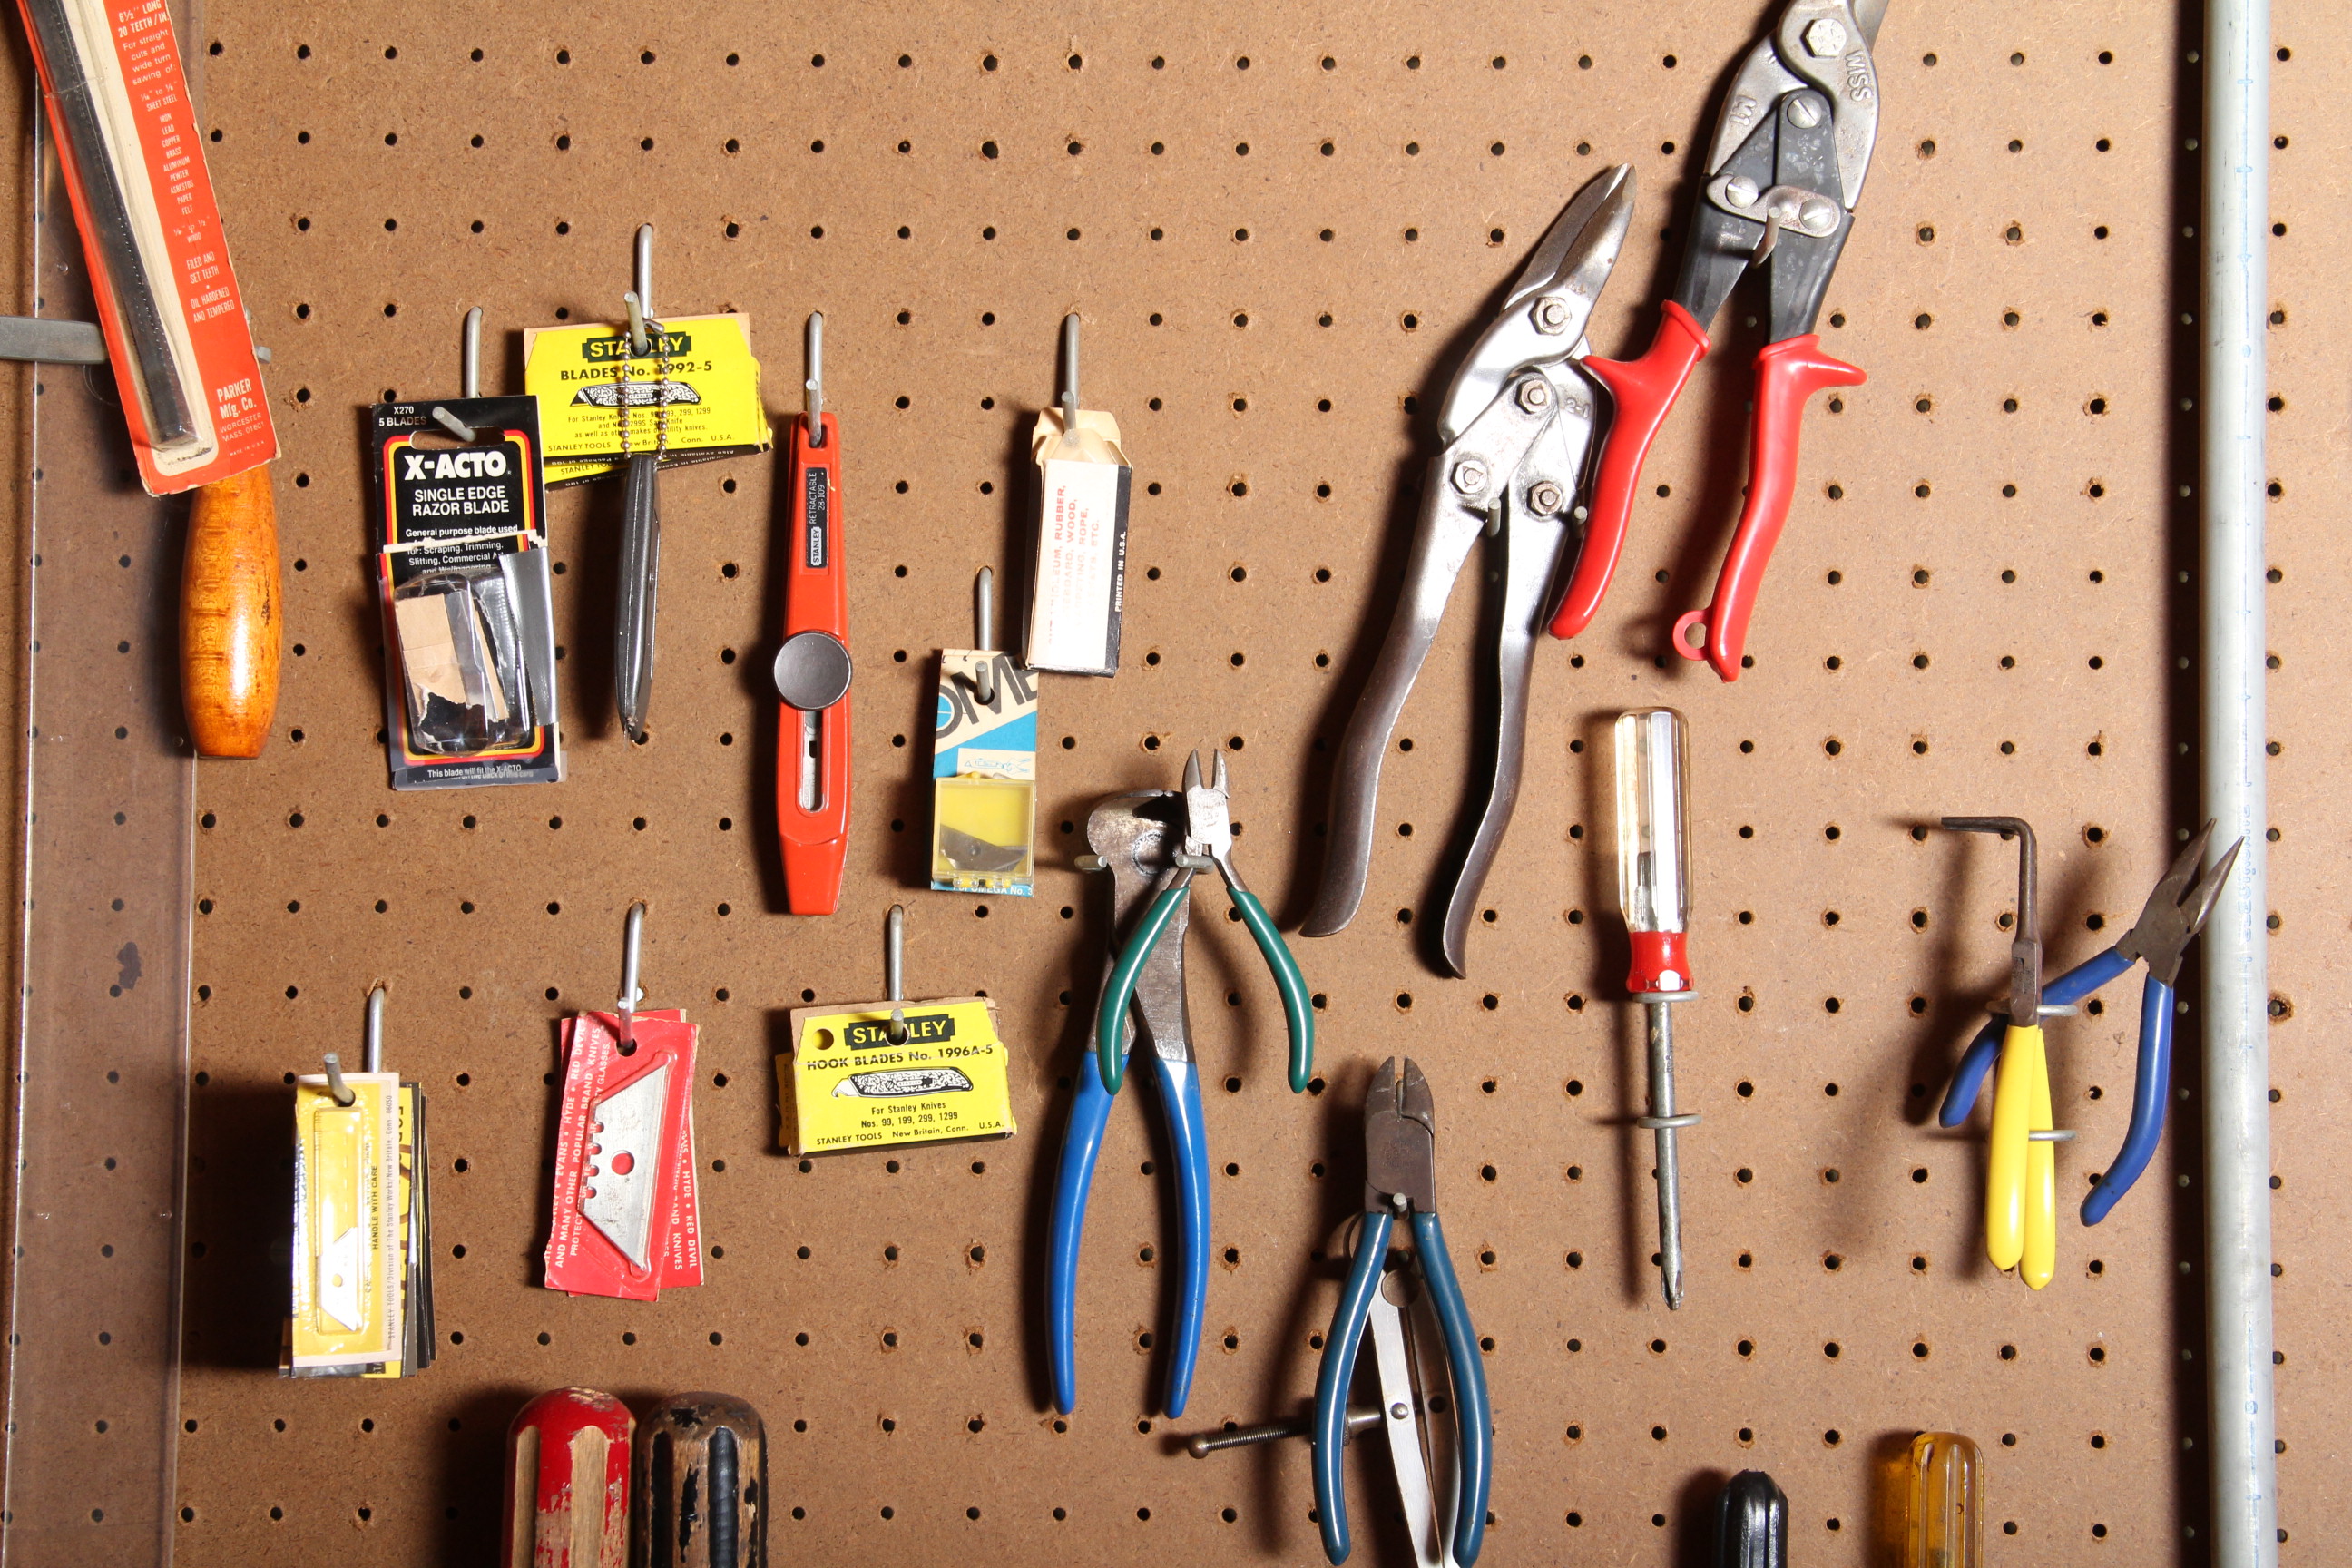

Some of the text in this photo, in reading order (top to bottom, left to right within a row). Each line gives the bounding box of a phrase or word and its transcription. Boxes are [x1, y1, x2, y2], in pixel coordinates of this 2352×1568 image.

[142, 0, 162, 15] LONG
[118, 26, 128, 38] 20
[122, 29, 169, 51] For straight
[131, 43, 165, 61] cuts and
[132, 54, 171, 73] wide turn
[132, 70, 162, 85] sawing
[1845, 49, 1873, 102] WISS
[146, 94, 178, 112] SHEET STEEL
[160, 113, 172, 123] IRON
[162, 124, 175, 135] LEAD
[162, 134, 181, 148] COPPER
[165, 146, 182, 159] BRASS
[163, 156, 191, 172] ALUMINUM
[170, 169, 190, 182] PEWTER
[170, 180, 194, 195] ASBESTOS
[177, 192, 193, 205] PAPER
[181, 205, 193, 216] FELT
[186, 251, 216, 270] FILED AND
[190, 265, 220, 284] SET TEETH
[190, 286, 230, 309] OIL HARDENED
[192, 299, 235, 323] AND TEMPERED
[561, 367, 618, 381] BLADES
[216, 378, 252, 403] PARKER
[219, 397, 257, 419] Mfg. Co.
[394, 406, 414, 415] X270
[220, 412, 262, 433] WORCESTER
[378, 416, 426, 426] 5 BLADES
[582, 415, 606, 423] Stanley
[548, 443, 583, 452] STANLEY
[404, 451, 507, 481] X-ACTO
[415, 486, 506, 503] SINGLE EDGE
[413, 500, 509, 516] RAZOR BLADE
[1054, 485, 1066, 540] RUBBER,
[1066, 499, 1078, 543] WOOD,
[1078, 508, 1089, 545] ROPE,
[406, 524, 518, 537] General purpose blade used
[424, 544, 463, 554] Scraping,
[464, 542, 504, 552] Trimming,
[408, 553, 490, 566] Slitting, Commercial
[1114, 531, 1126, 612] PRINTED IN U.S.A.
[427, 769, 443, 778] This
[445, 769, 463, 777] blade
[464, 767, 476, 776] will
[476, 767, 485, 775] fit
[485, 766, 495, 774] the
[496, 764, 522, 773] X-ACTO
[1010, 887, 1025, 896] No.
[807, 1044, 993, 1071] HOOK BLADES No. 1996A-5
[581, 1073, 593, 1110] BRAND
[871, 1102, 946, 1115] For Stanley Knives
[555, 1142, 568, 1177] EVANS
[564, 1097, 575, 1124] HYDE
[570, 1061, 581, 1080] RED
[861, 1112, 958, 1128] Nos. 99, 199, 299, 1299
[572, 1114, 586, 1163] POPULAR
[817, 1122, 1004, 1146] STANLEY TOOLS New Britain, Conn. U.S.A.
[570, 1212, 583, 1257] PROTECT
[597, 1042, 611, 1085] GLASSES.
[565, 1171, 578, 1205] OTHER
[386, 1203, 394, 1227] Stanley
[682, 1171, 698, 1269] HYDE RED DEVIL
[560, 1208, 572, 1241] MANY
[386, 1229, 394, 1242] The
[554, 1244, 566, 1269] AND
[672, 1232, 682, 1270] KNIVES
